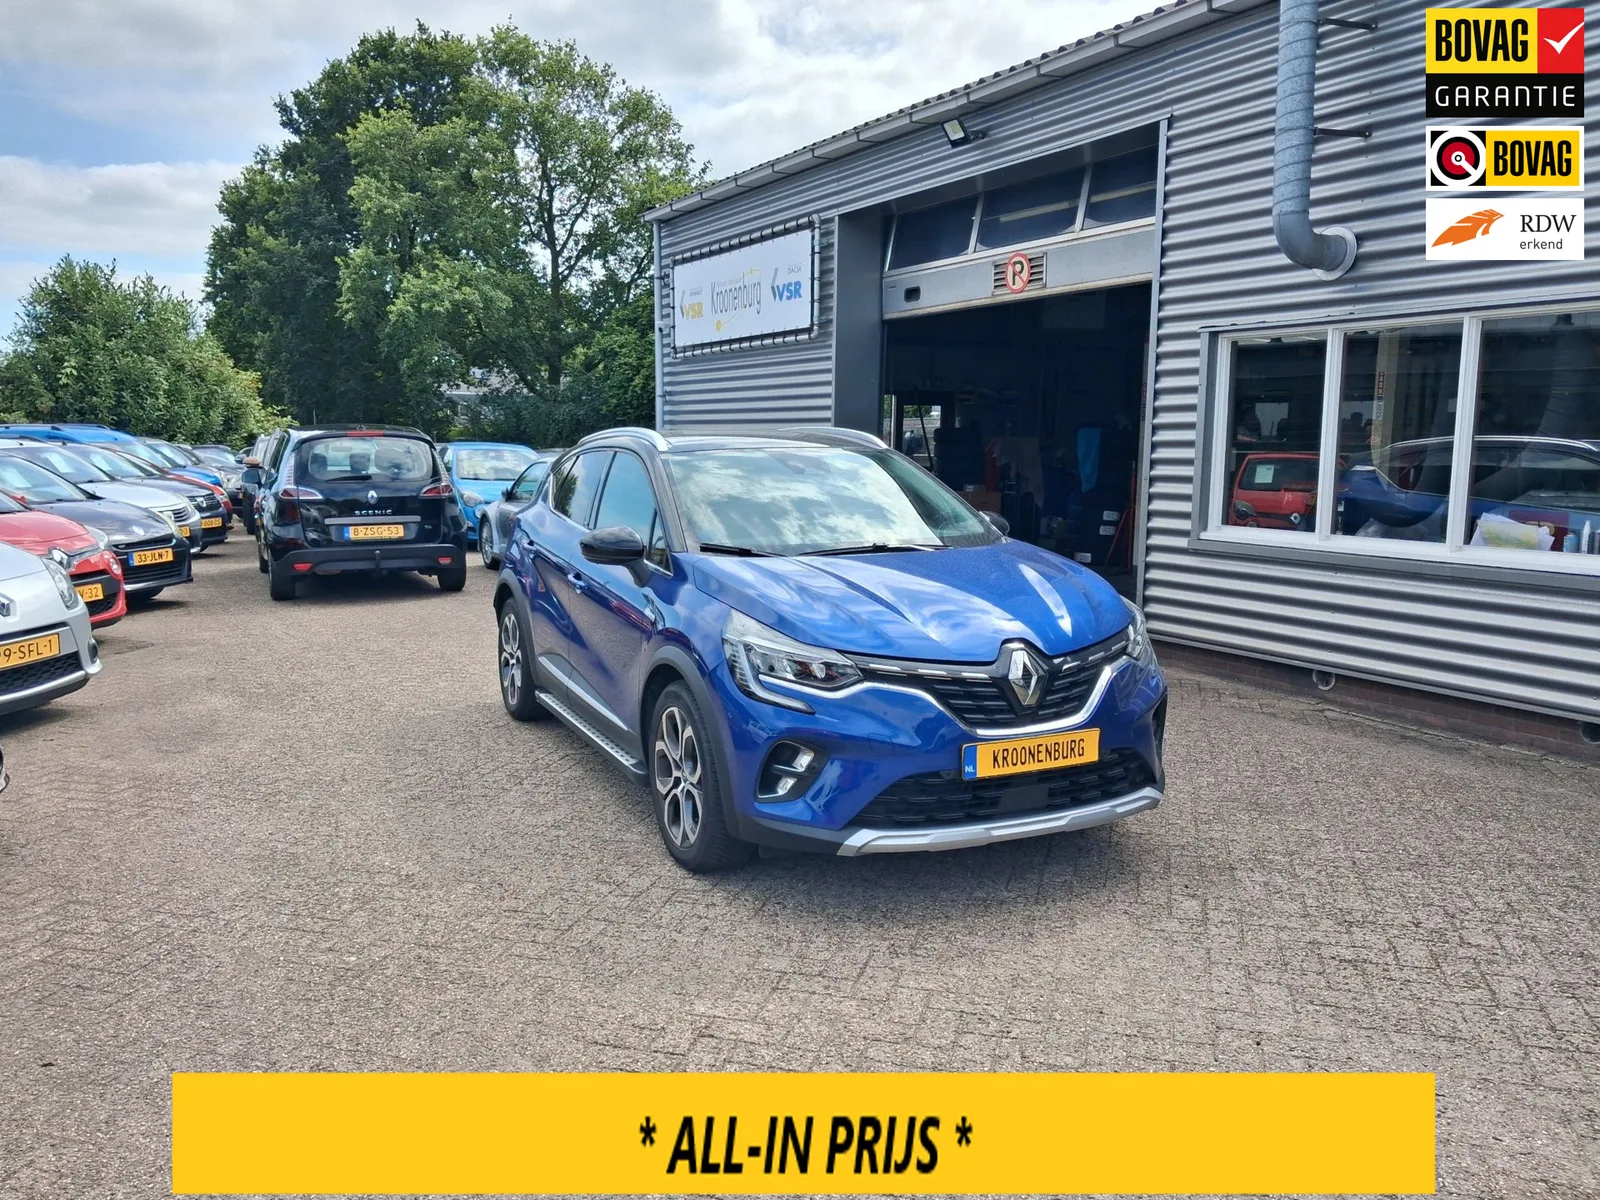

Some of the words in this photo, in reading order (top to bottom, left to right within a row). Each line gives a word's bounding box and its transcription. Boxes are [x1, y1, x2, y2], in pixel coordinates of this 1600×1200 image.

[710, 272, 762, 315] Kroonenburg
[776, 280, 803, 302] VSR
[684, 302, 704, 321] VSR
[353, 526, 400, 537] 8-ZSG-53
[137, 550, 169, 564] 33-JLN-7
[0, 639, 53, 663] 9-SFL-1
[992, 738, 1085, 769] KROONENBURG
